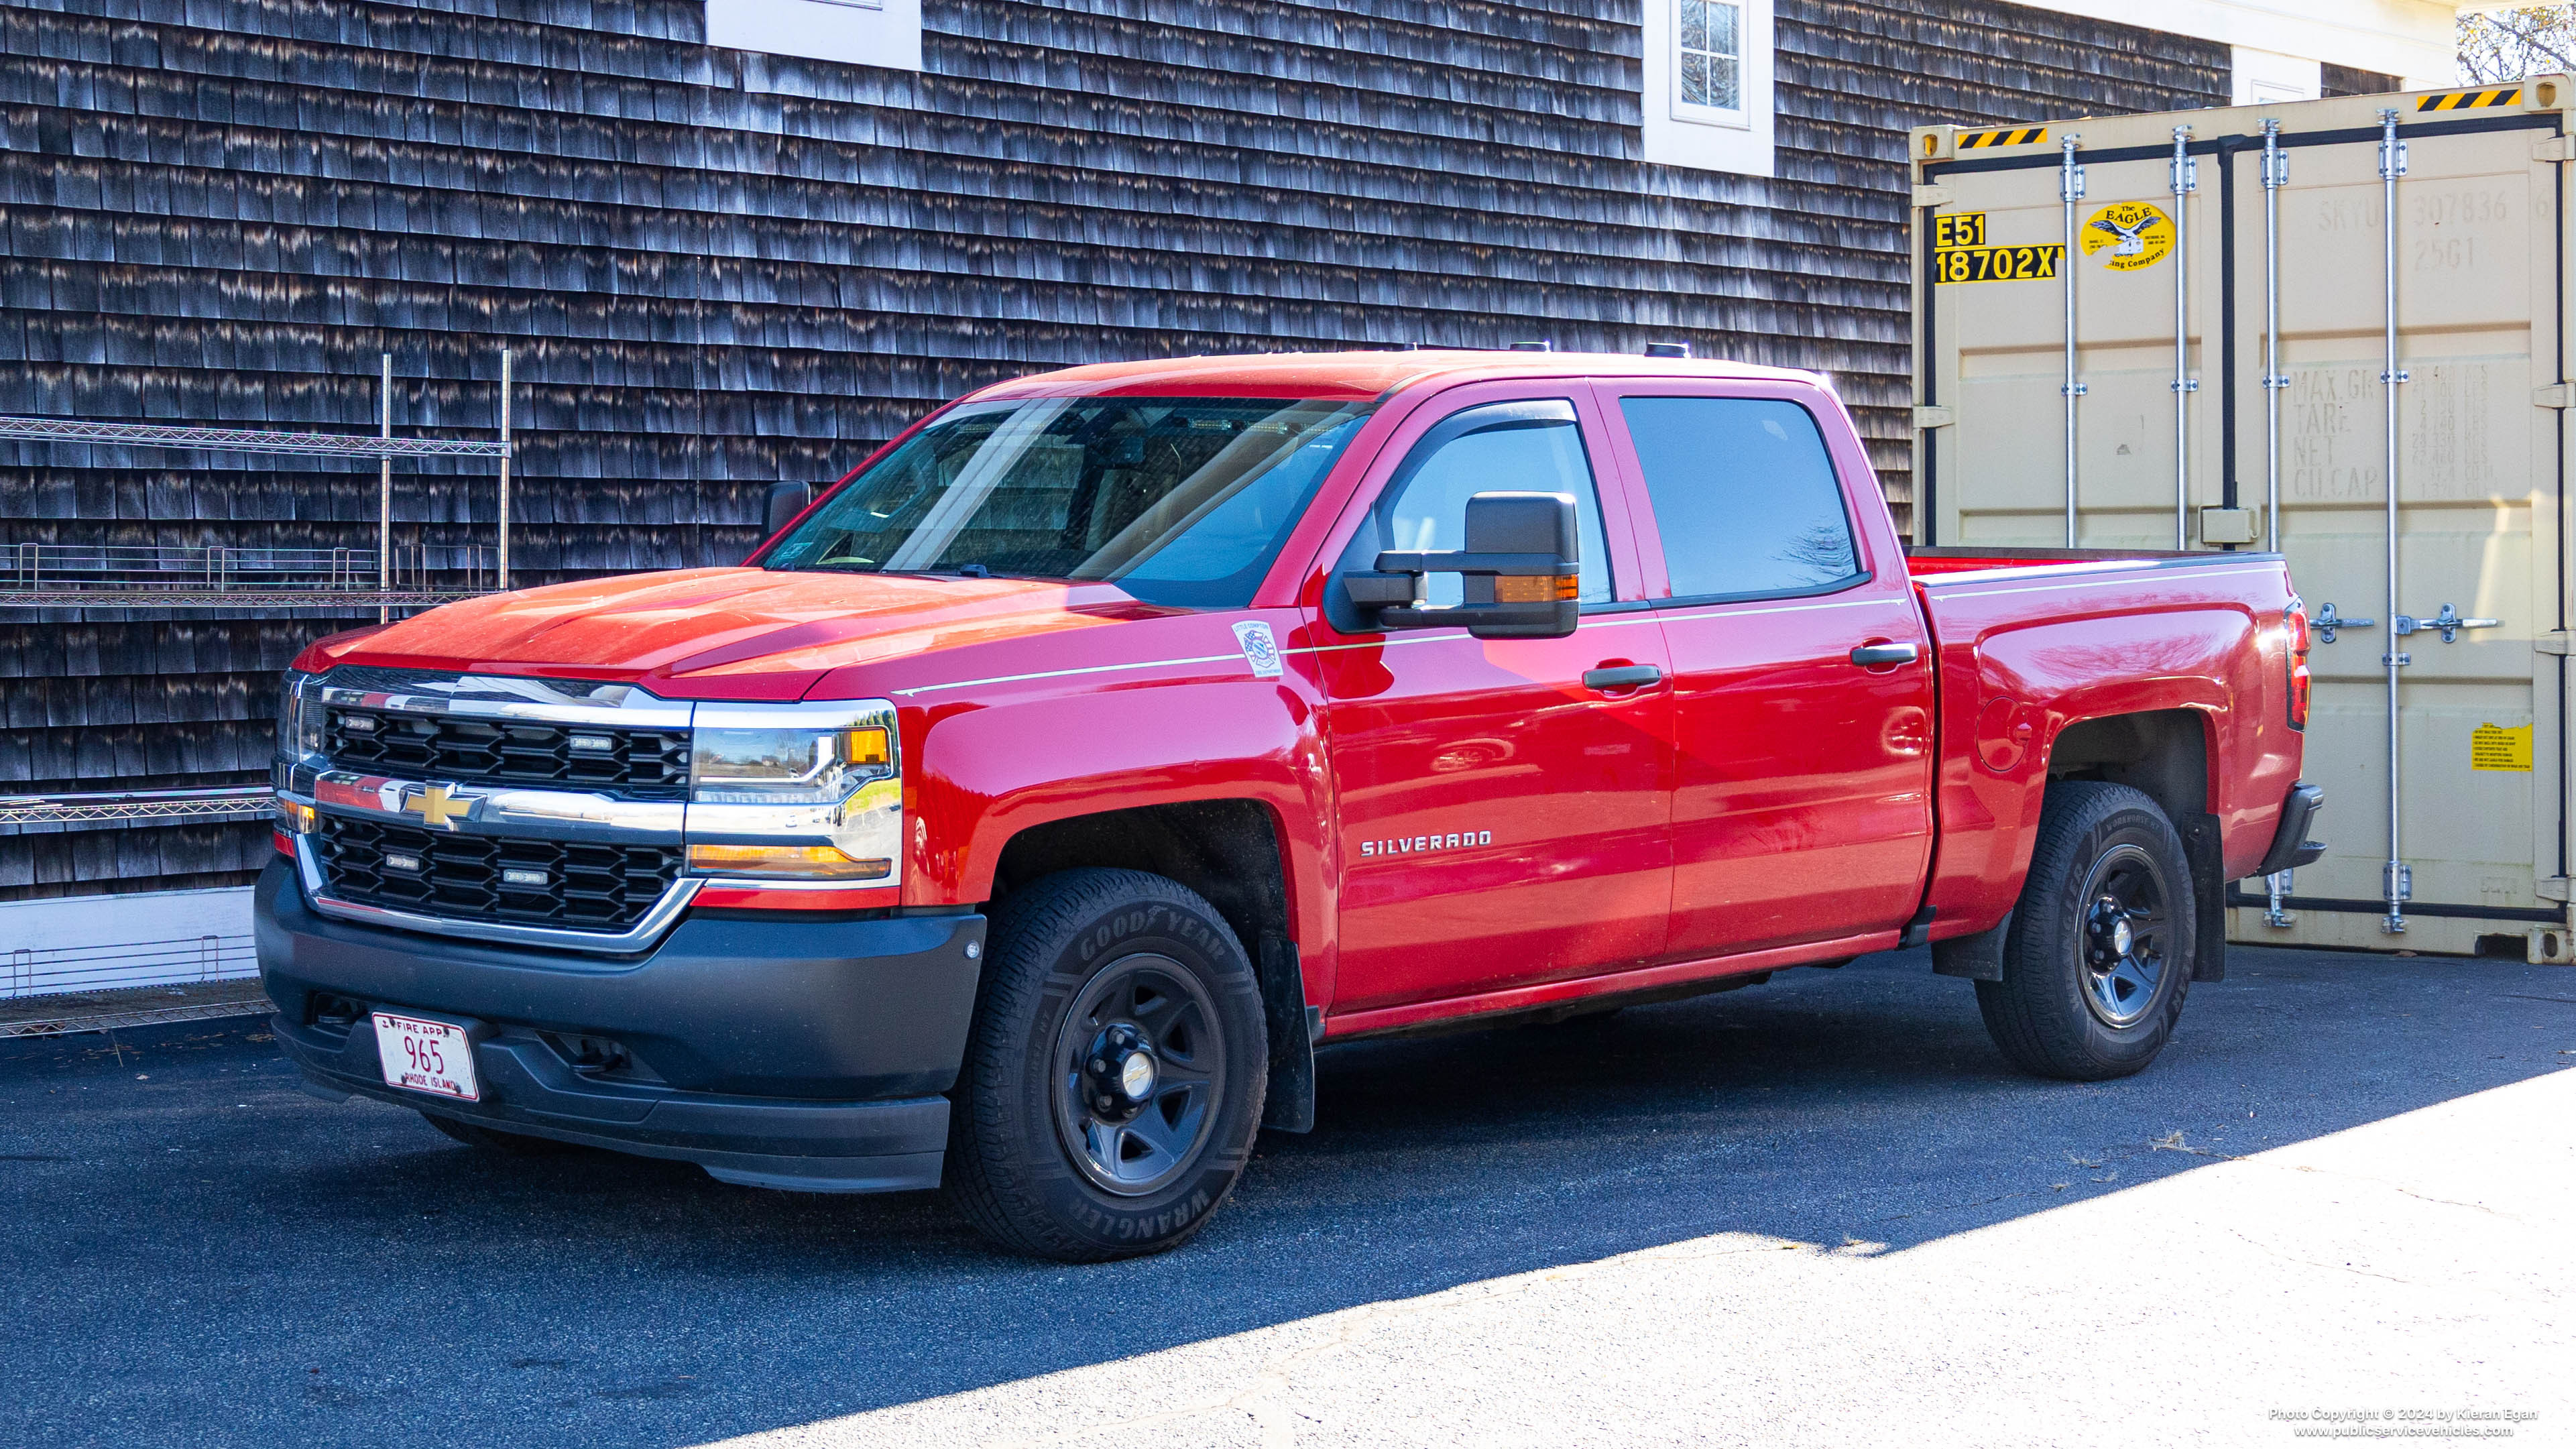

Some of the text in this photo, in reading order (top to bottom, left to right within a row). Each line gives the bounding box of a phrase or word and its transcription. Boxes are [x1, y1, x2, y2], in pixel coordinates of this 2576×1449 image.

[2106, 207, 2152, 223] EAGLE
[1936, 215, 1985, 247] E51
[2109, 248, 2165, 268] ing Company
[2293, 402, 2352, 434] TARE
[2293, 435, 2337, 467] NET
[1360, 830, 1492, 857] SILVERADO
[397, 1021, 419, 1033] FIRE
[404, 1036, 444, 1074] 965
[404, 1072, 457, 1091] RHODE ISLAND
[1070, 1187, 1212, 1239] WRANGLER
